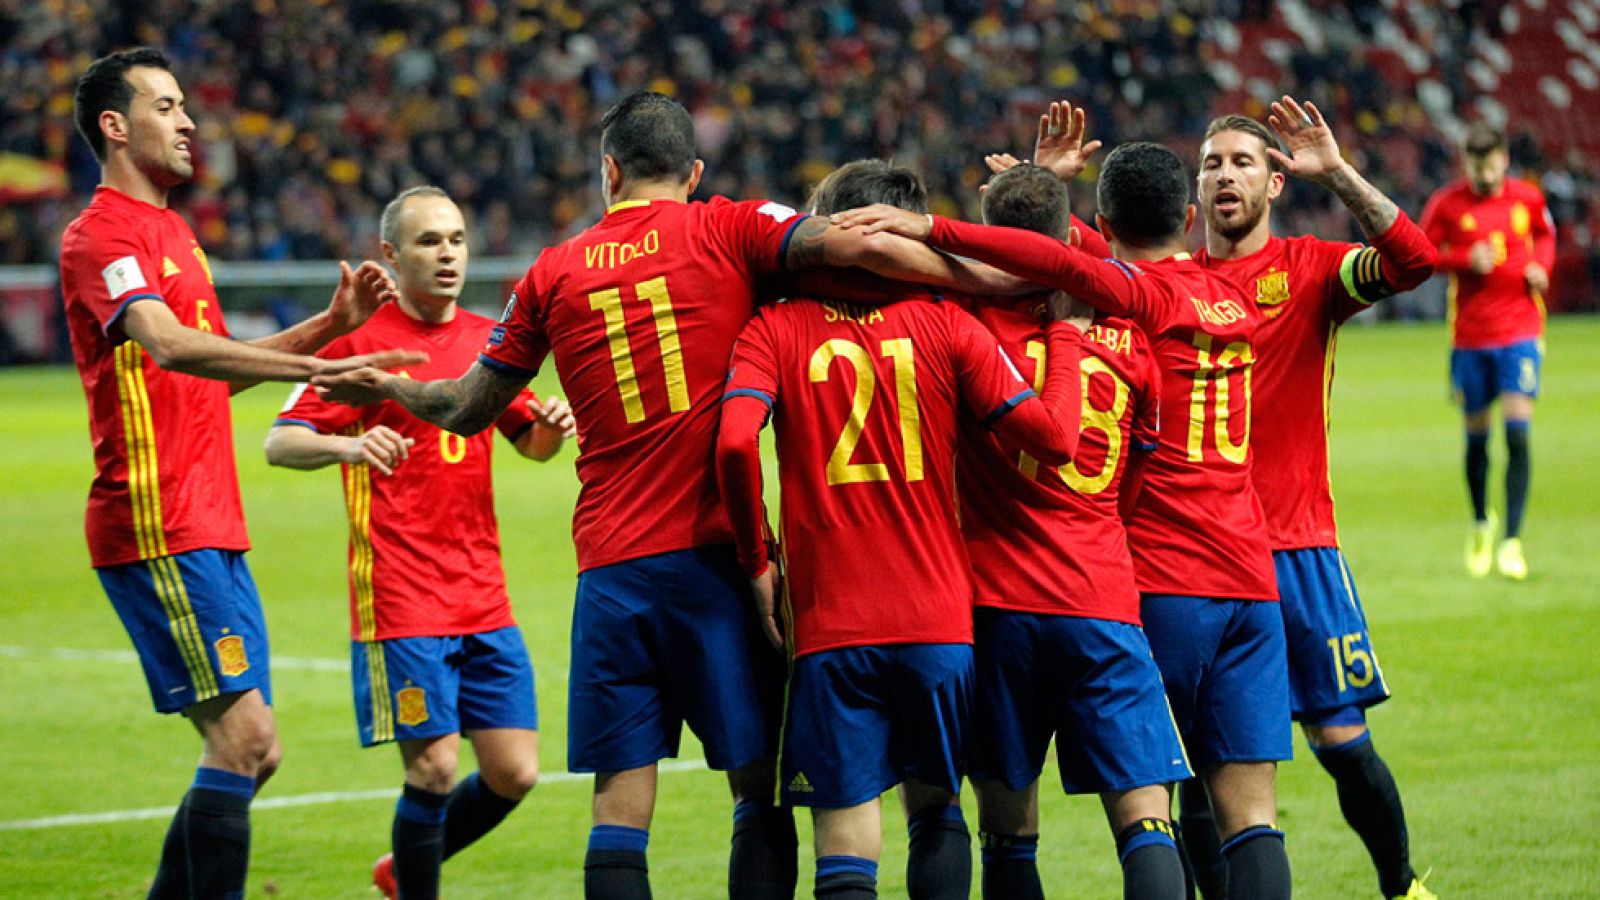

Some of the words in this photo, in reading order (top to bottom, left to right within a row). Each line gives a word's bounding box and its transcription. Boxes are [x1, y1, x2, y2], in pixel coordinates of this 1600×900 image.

[585, 229, 659, 269] VITOLO
[196, 299, 212, 332] 5
[823, 301, 884, 325] SILVA
[1190, 296, 1247, 326] THGO
[588, 276, 691, 424] 11
[809, 338, 925, 486] 21
[1017, 339, 1131, 495] 18
[1187, 330, 1256, 464] 10
[1327, 632, 1374, 692] 15
